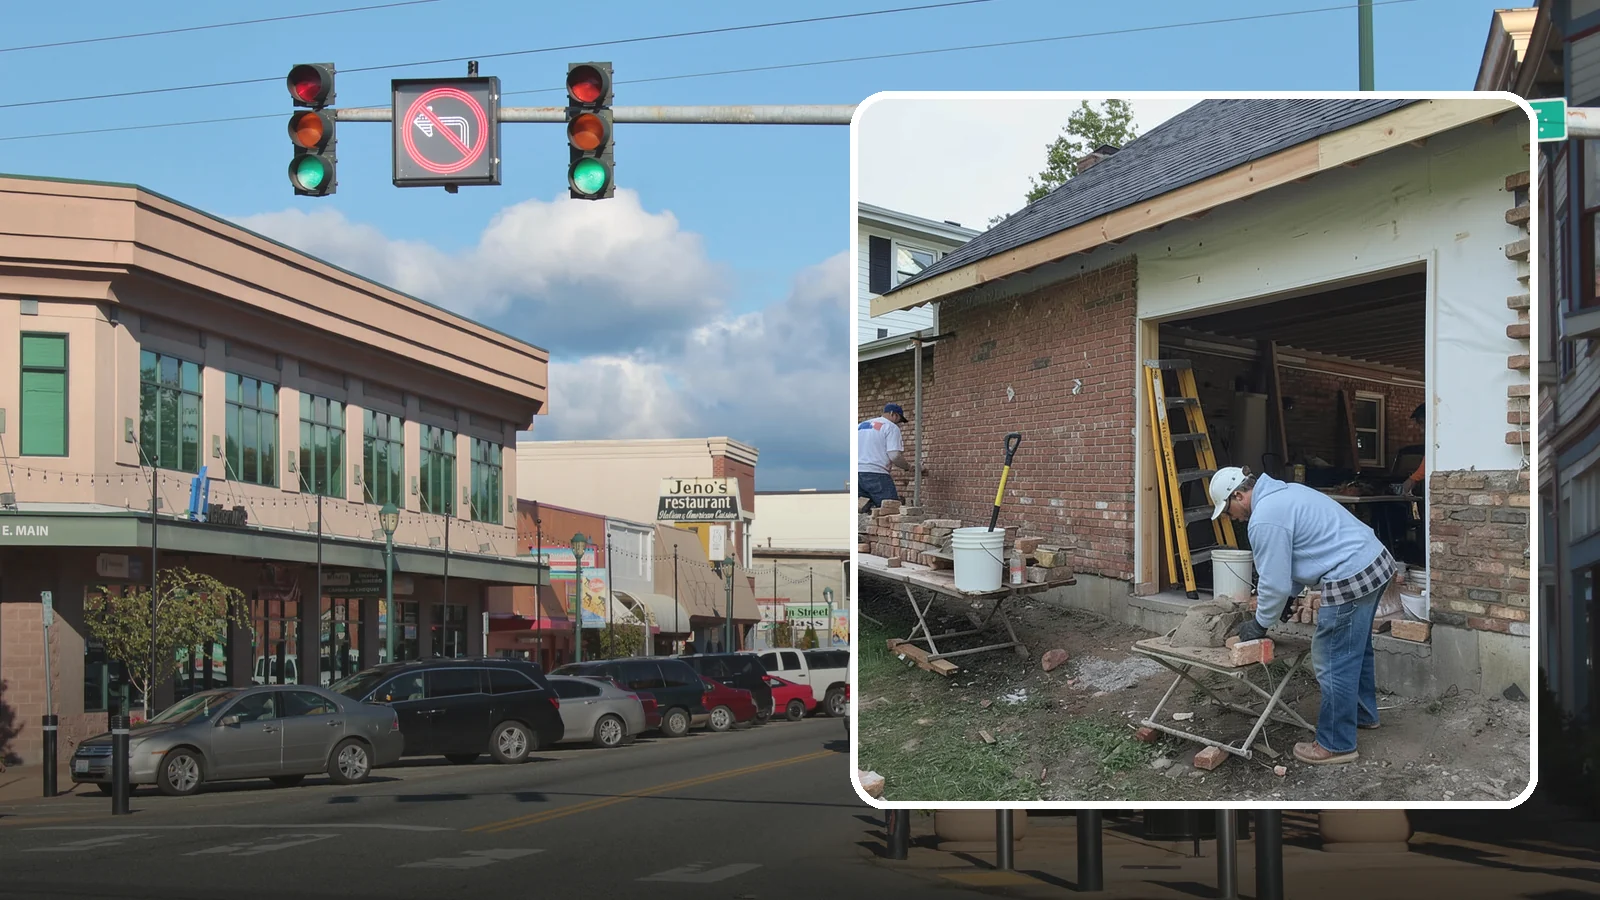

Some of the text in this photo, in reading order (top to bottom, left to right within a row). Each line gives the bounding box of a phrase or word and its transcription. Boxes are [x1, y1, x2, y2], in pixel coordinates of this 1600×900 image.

[670, 480, 727, 494] Jeno's
[665, 496, 731, 509] restaurant
[659, 510, 681, 519] Italian
[686, 510, 714, 519] American
[715, 510, 737, 519] Cuisine
[2, 525, 49, 536] E. MAIN
[797, 608, 828, 616] Street
